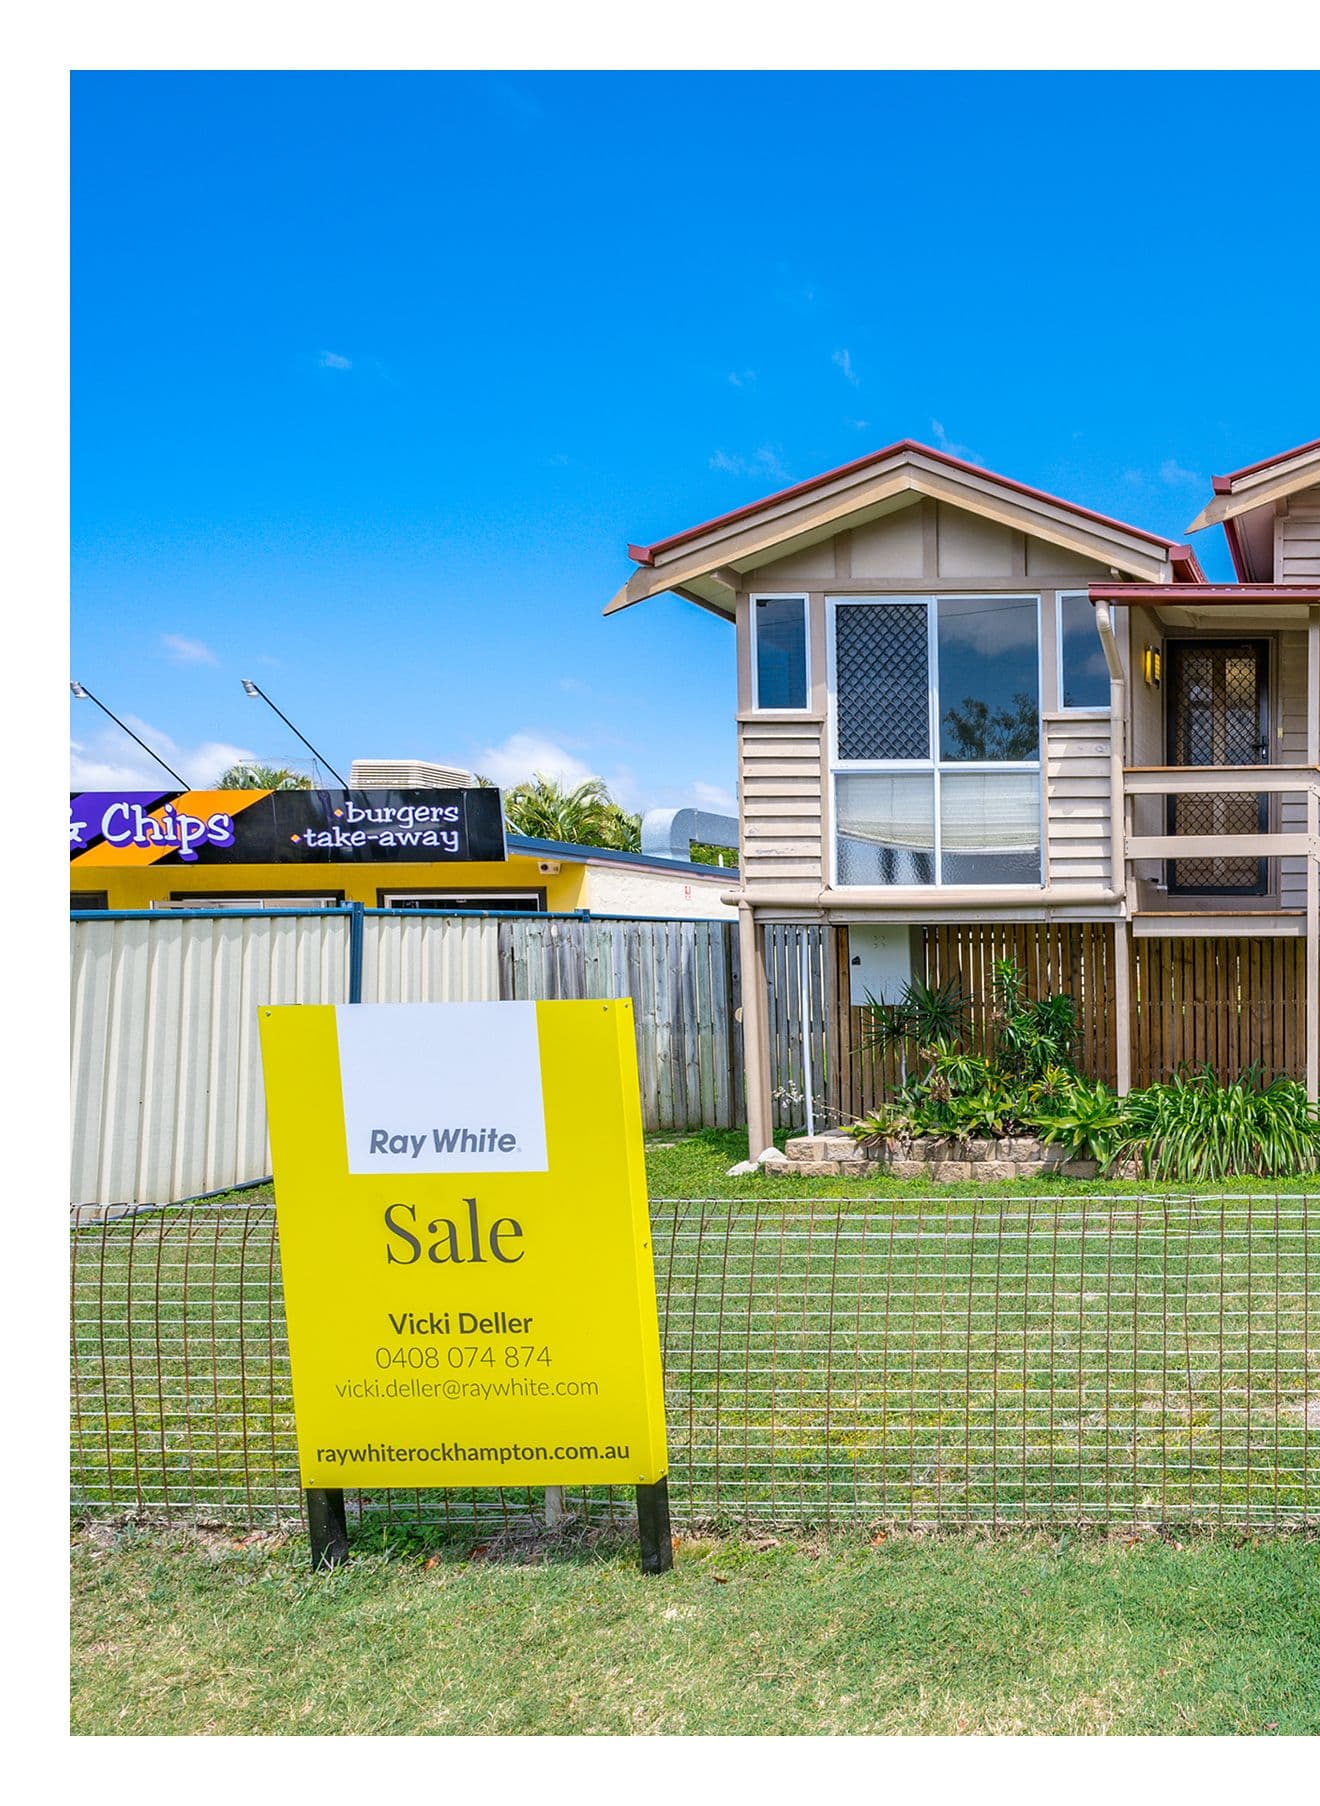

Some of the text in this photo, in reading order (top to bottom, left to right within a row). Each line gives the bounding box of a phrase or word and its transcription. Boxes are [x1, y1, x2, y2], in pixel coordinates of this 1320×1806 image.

[345, 801, 459, 828] burgers
[101, 801, 234, 857] Chips
[304, 826, 459, 852] take-away
[369, 1128, 516, 1158] Ray White
[384, 1198, 526, 1265] Sale
[388, 1311, 534, 1335] Vicki Deller
[375, 1345, 553, 1369] 0408 074 874
[335, 1378, 599, 1400] vicki.deller@raywhite.com
[316, 1442, 630, 1466] raywhiterockhampton.com.au
